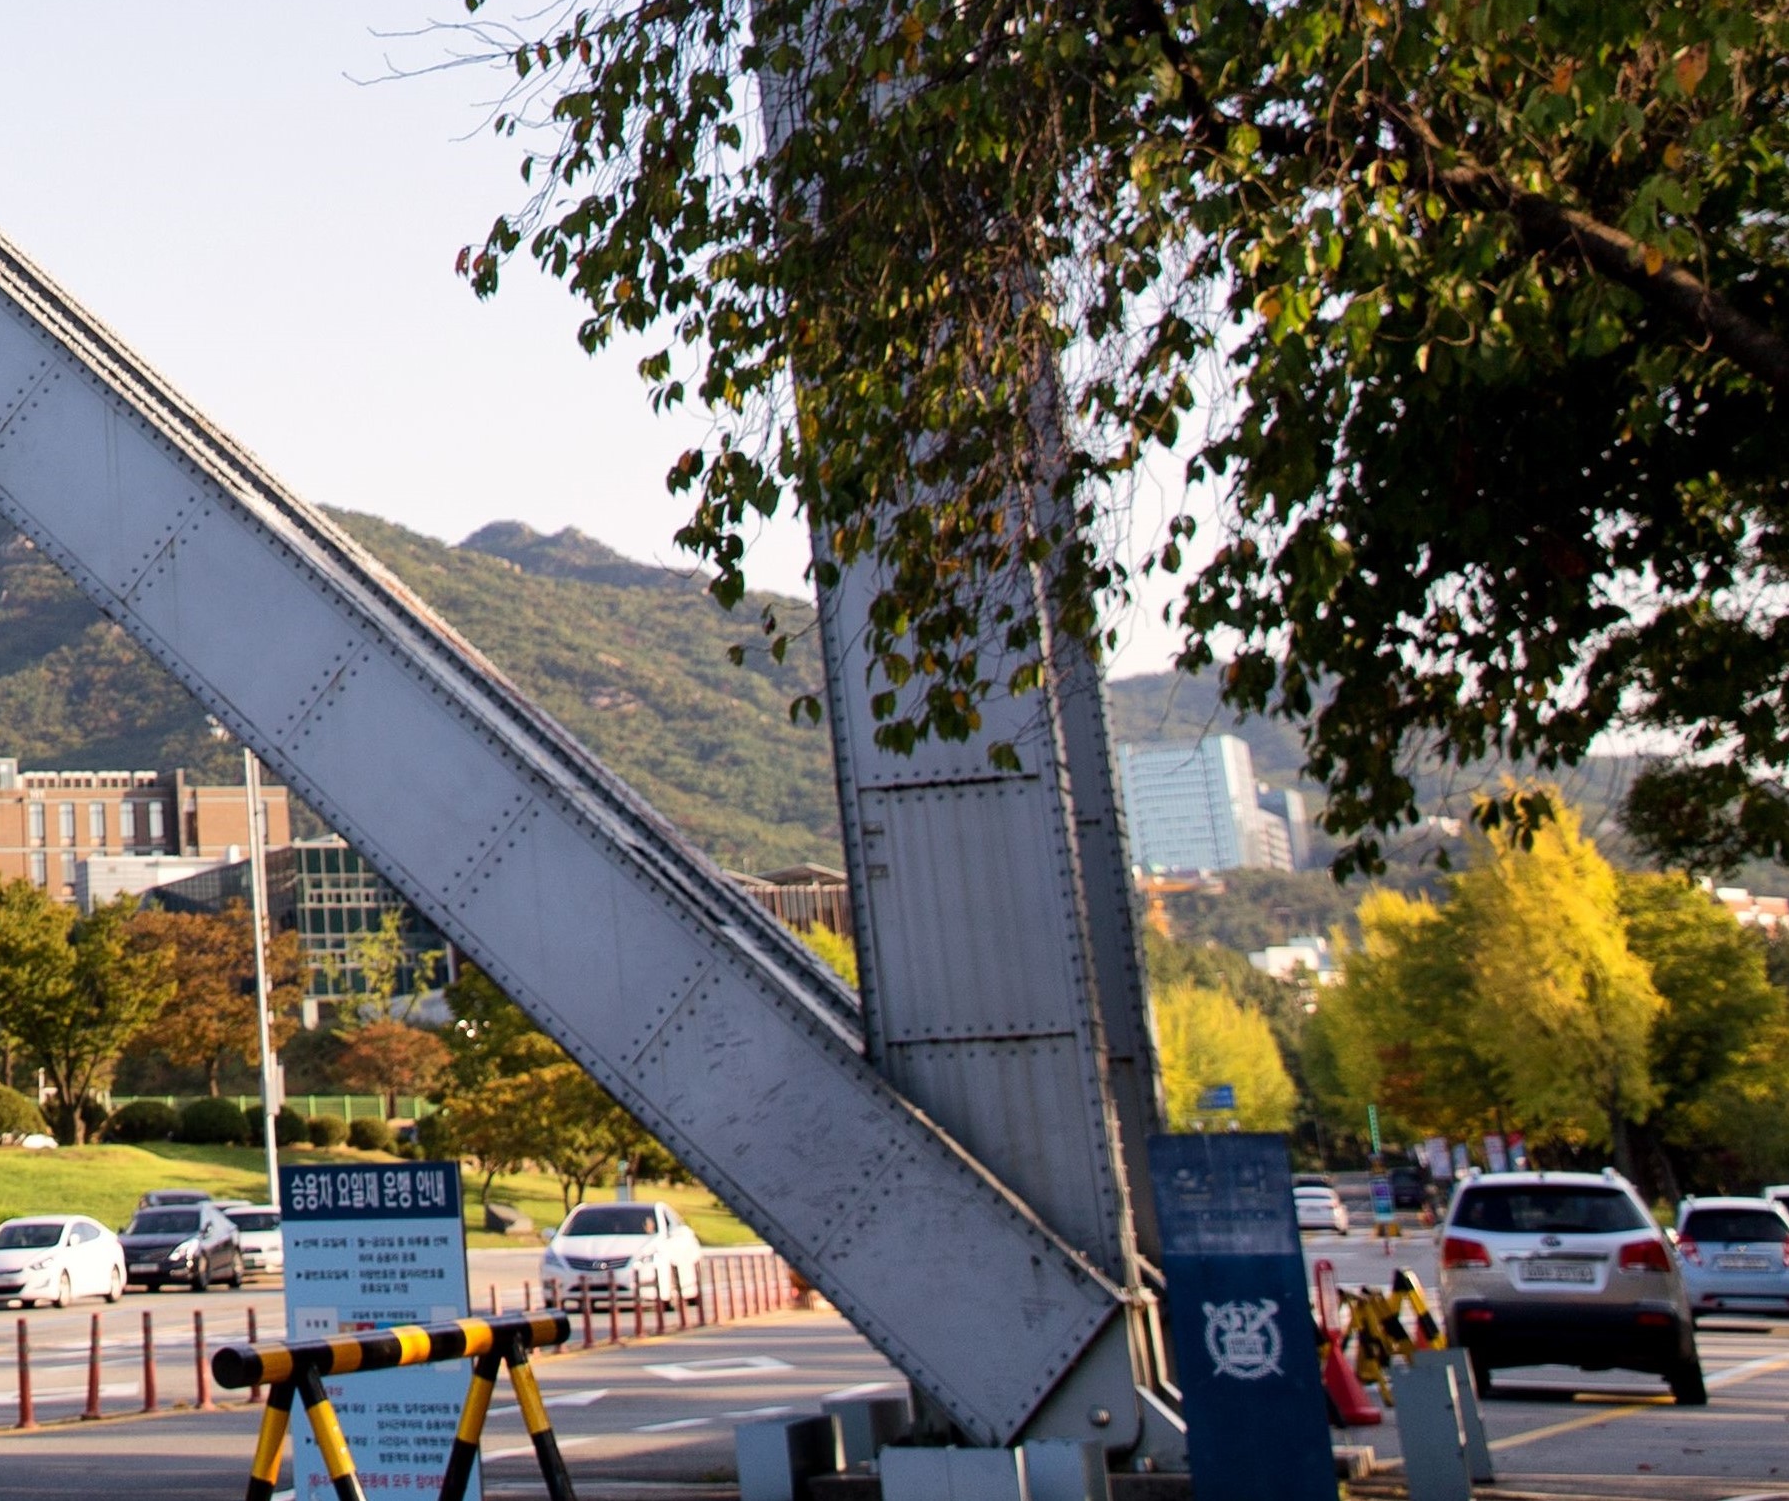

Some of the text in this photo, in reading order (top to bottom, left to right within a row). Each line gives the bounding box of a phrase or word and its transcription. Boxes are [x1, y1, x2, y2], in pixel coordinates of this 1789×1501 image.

[291, 1170, 446, 1211] 승용차 요일제 운행 안내
